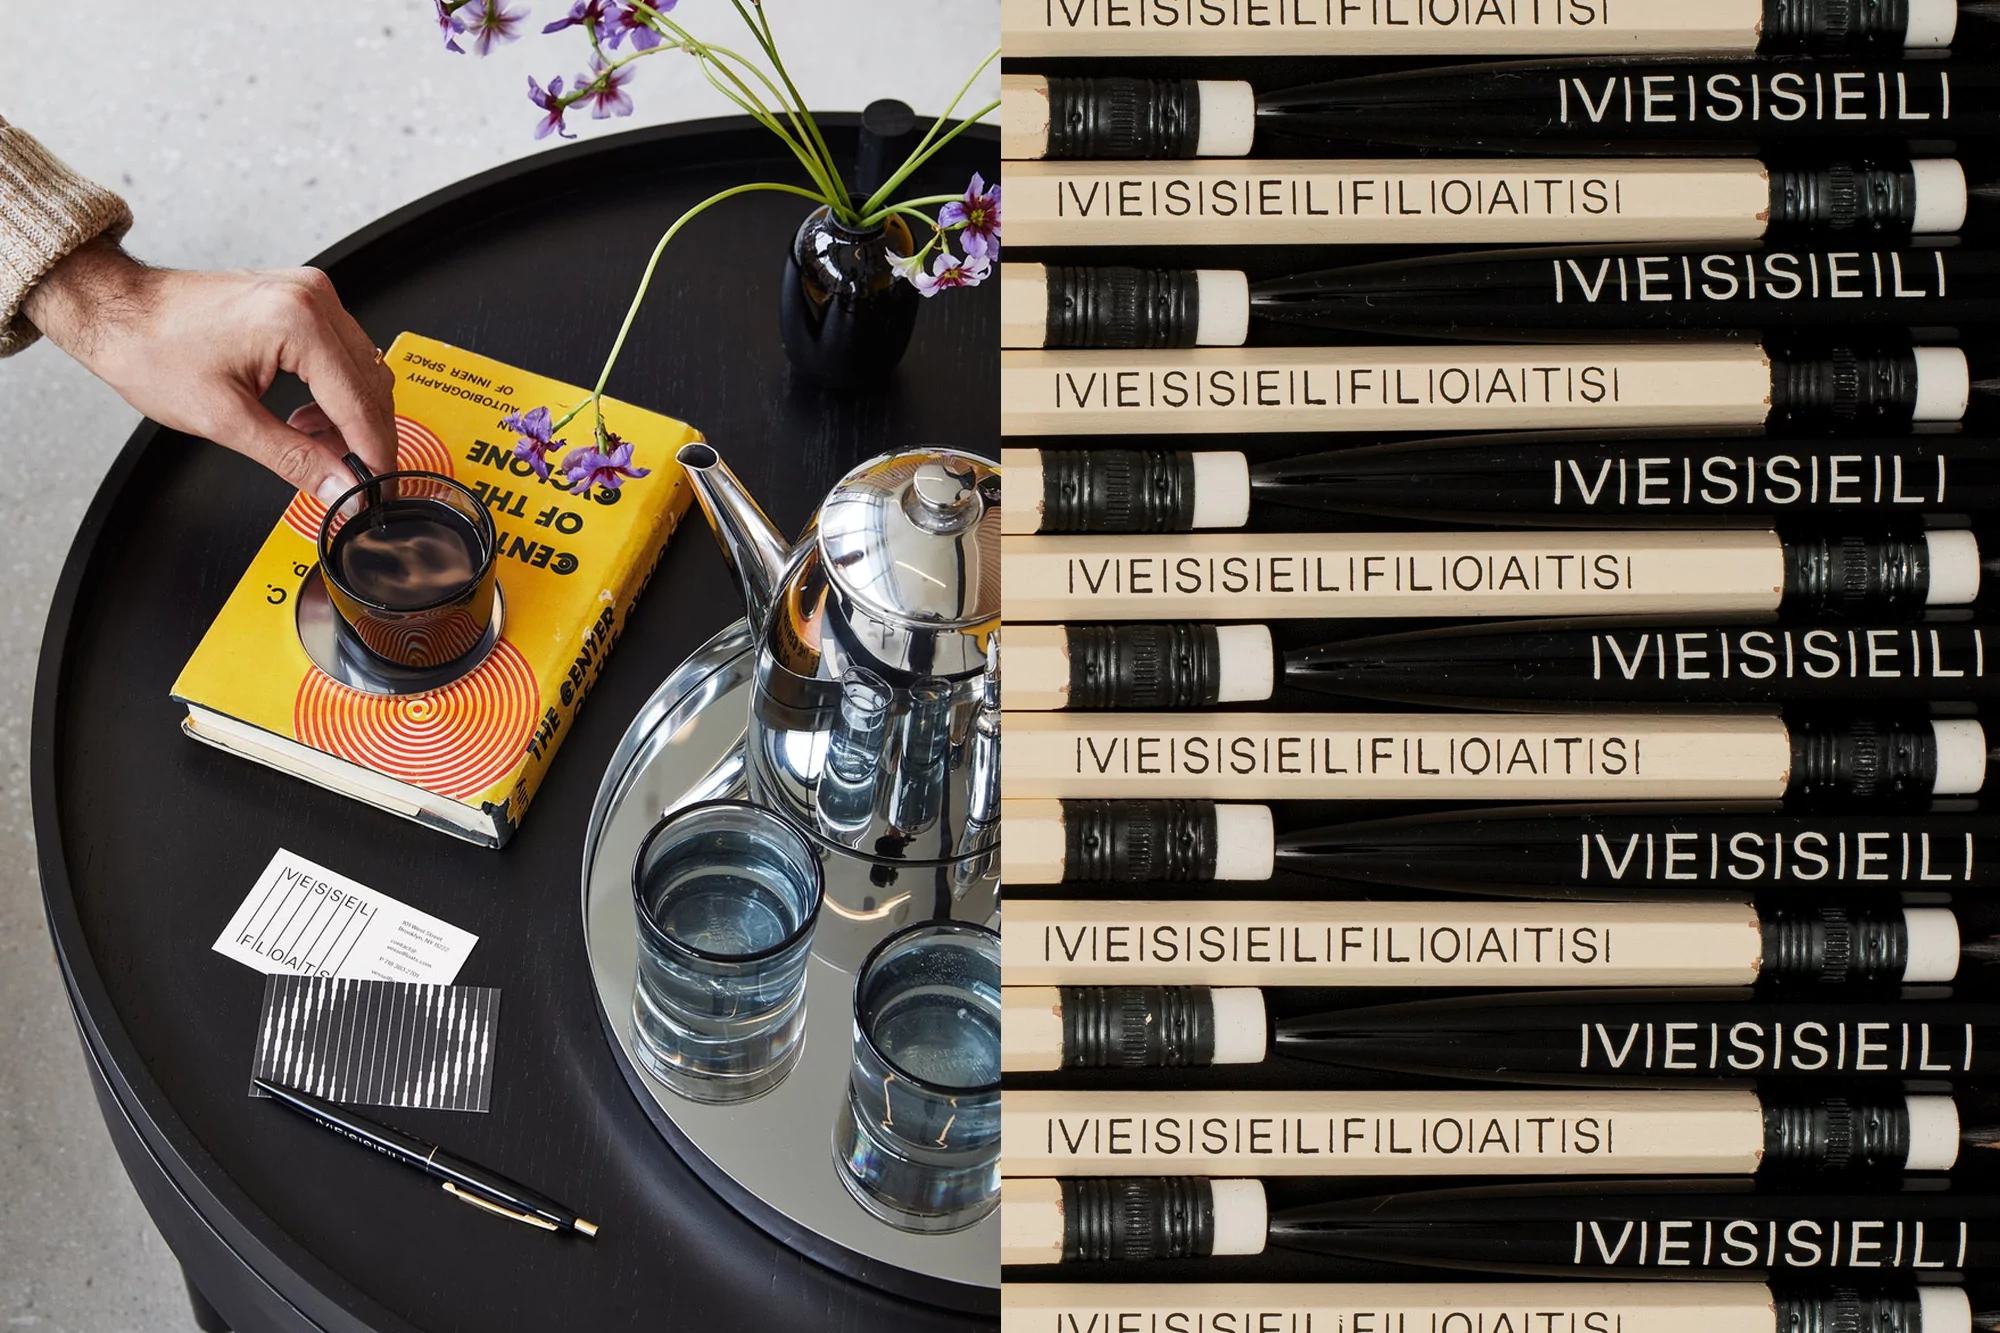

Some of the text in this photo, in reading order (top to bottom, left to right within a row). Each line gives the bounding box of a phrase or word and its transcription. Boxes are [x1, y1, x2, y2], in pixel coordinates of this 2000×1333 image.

[403, 352, 514, 396] OF INNER SPACE
[406, 372, 520, 414] AUTOBIOGRAPHY
[472, 480, 583, 535] OF THE
[497, 531, 579, 575] CENT
[527, 606, 616, 762] THE CENTER
